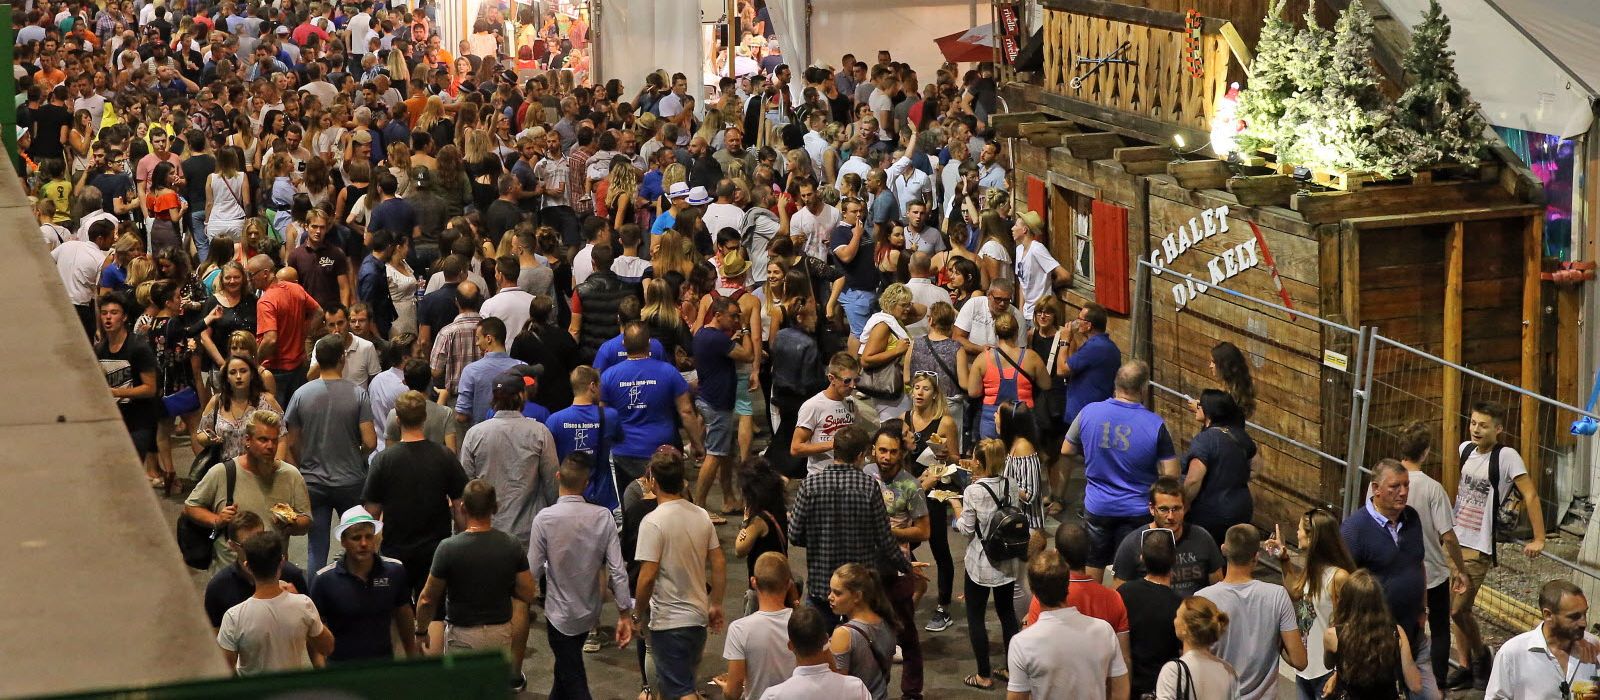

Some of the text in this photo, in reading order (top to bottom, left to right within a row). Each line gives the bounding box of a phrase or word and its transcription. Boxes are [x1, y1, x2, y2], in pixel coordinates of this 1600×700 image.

[1003, 8, 1015, 31] rivella
[1005, 38, 1018, 61] rivella
[1150, 205, 1230, 275] CHALET
[1098, 421, 1132, 452] 18
